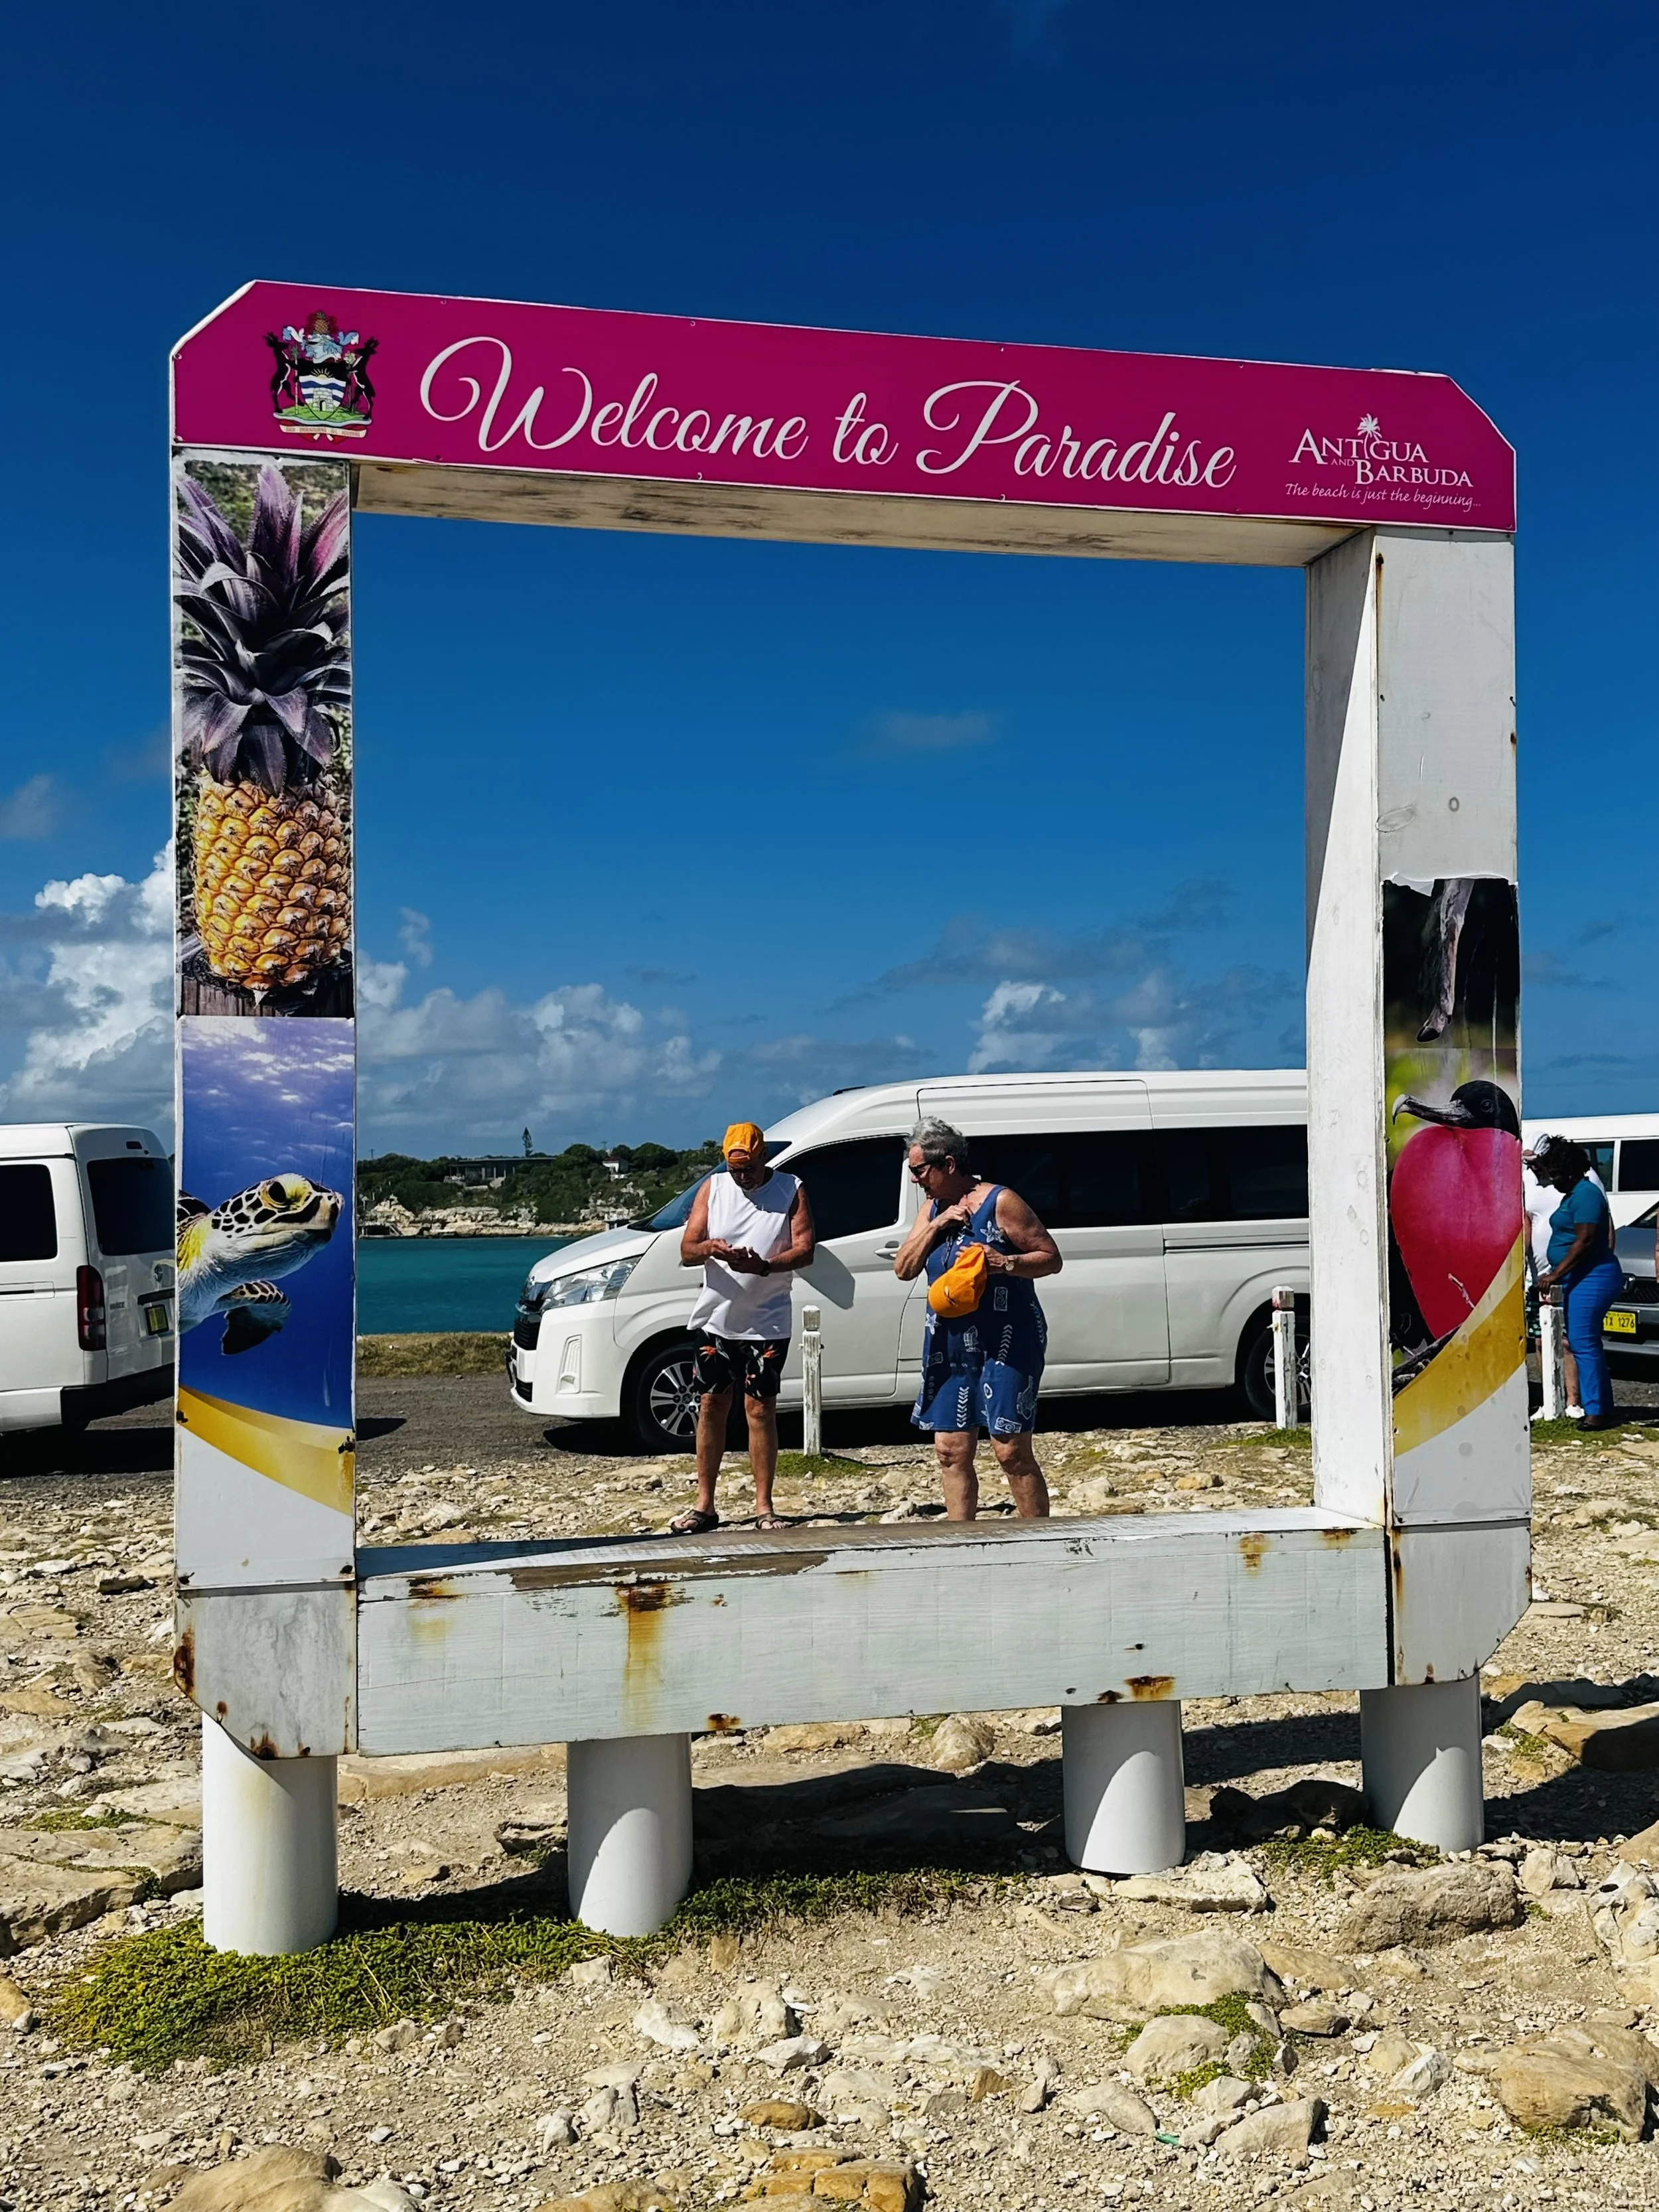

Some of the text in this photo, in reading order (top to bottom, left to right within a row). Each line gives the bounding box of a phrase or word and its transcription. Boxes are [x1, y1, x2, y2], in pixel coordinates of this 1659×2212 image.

[420, 336, 1236, 488] Welcome to Paradise
[1289, 413, 1429, 465] ANTIGUA
[1331, 458, 1354, 467] AND
[1354, 459, 1474, 487] BARBUDA
[1285, 482, 1481, 512] The beach is just the beginning...
[1618, 1317, 1634, 1329] 1276
